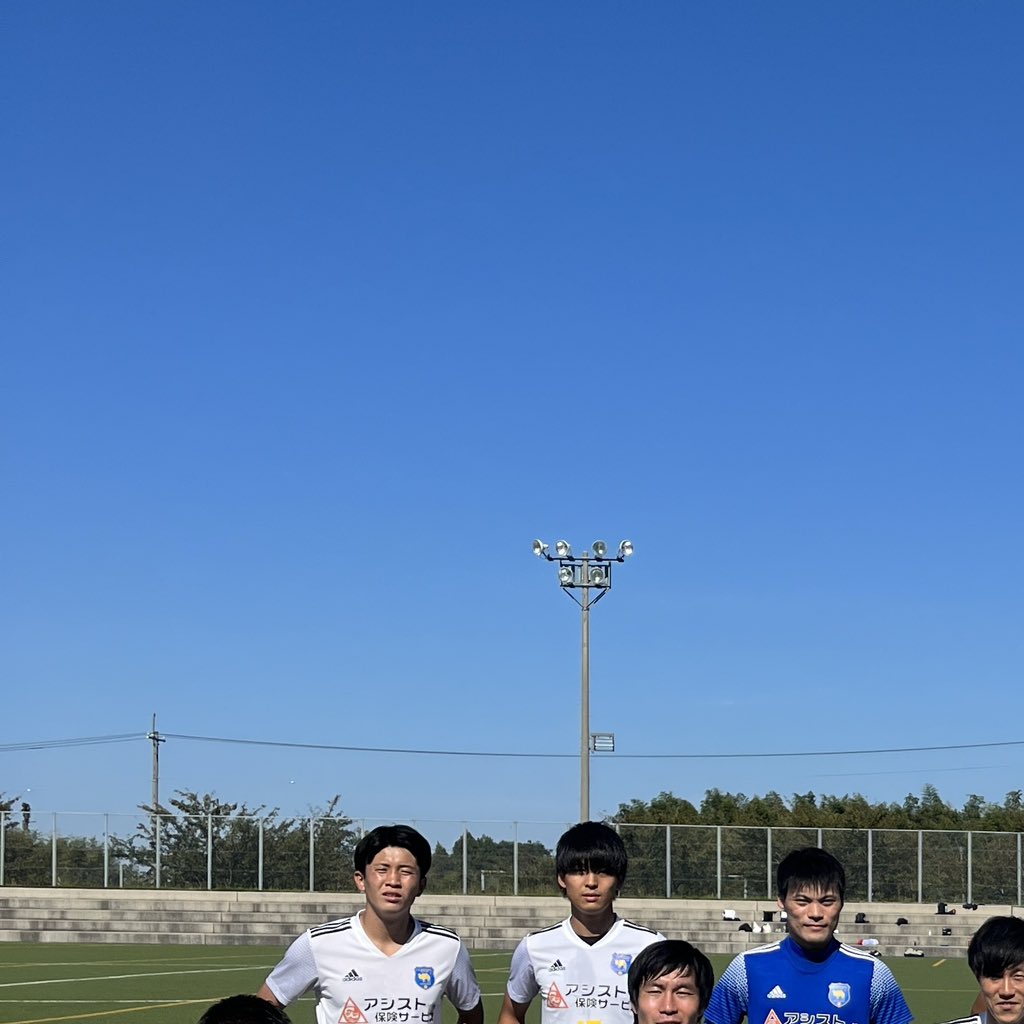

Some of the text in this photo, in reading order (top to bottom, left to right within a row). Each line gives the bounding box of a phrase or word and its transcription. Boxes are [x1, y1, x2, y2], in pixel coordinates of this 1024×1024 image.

[565, 983, 627, 998] アシスト
[364, 997, 427, 1012] アシスト
